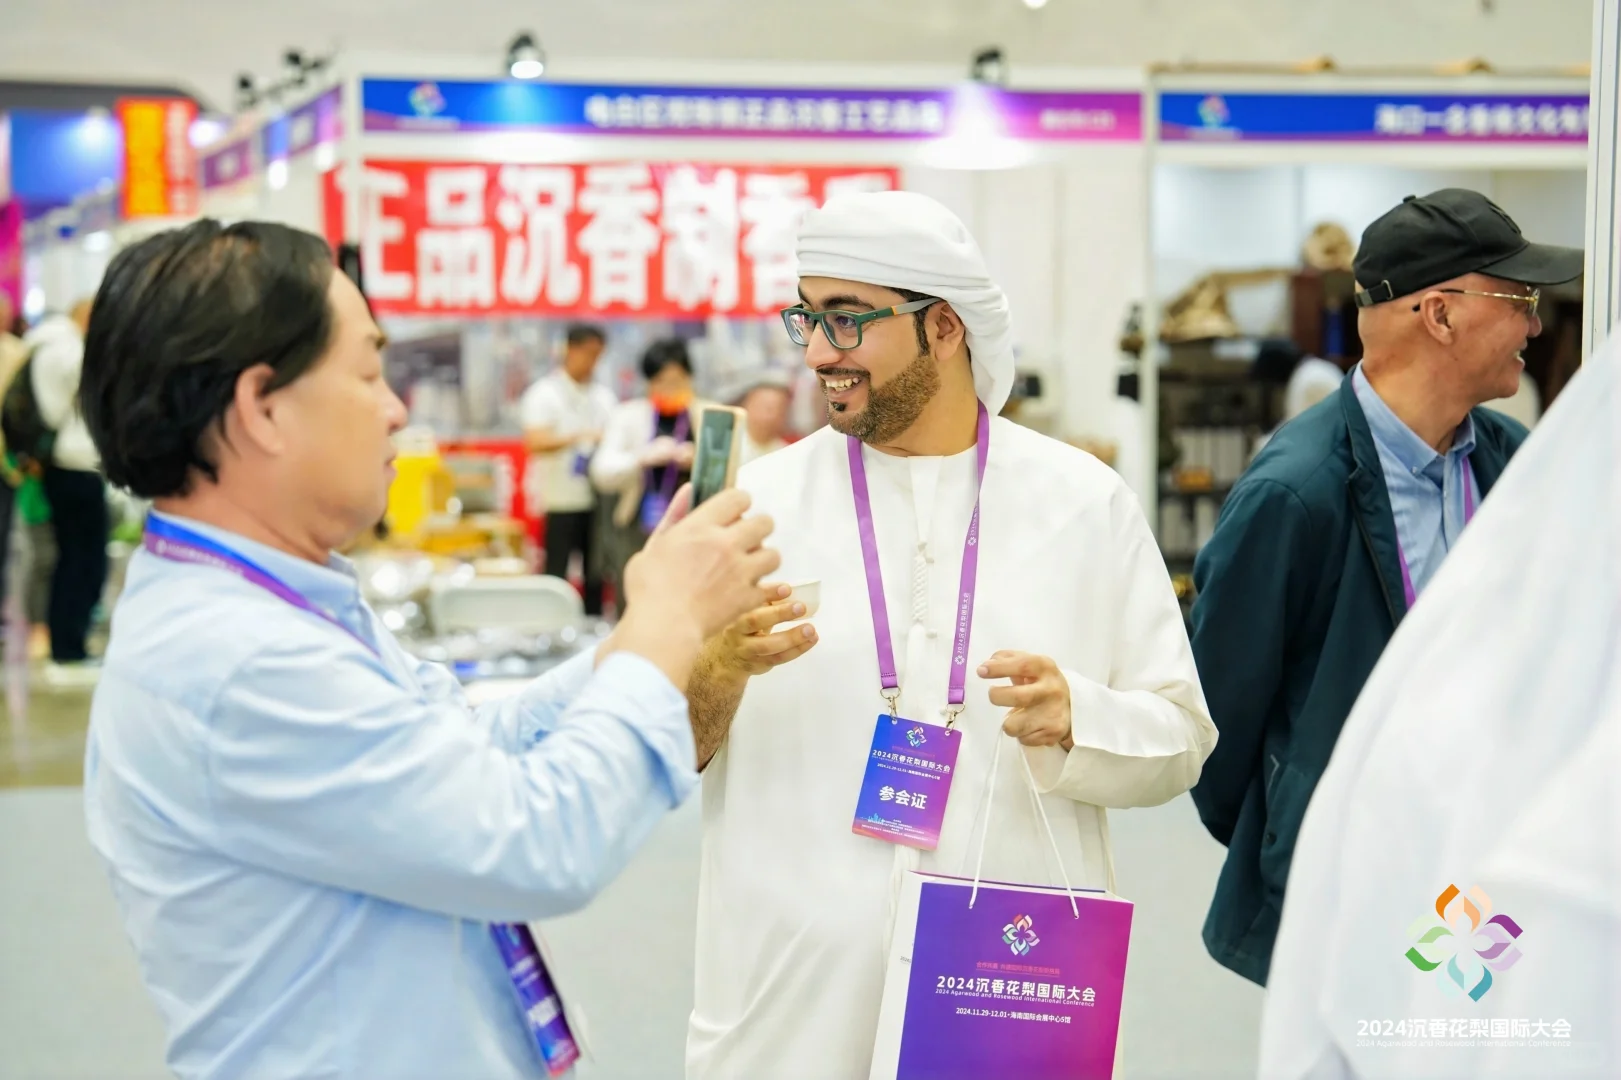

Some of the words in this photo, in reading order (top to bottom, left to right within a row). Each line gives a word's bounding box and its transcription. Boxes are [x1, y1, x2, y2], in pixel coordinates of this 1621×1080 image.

[336, 164, 893, 314] 正品沉香制香
[872, 749, 951, 773] 2024沉香花梨国际大会
[879, 785, 927, 810] 参会证
[936, 976, 1096, 1002] 2024沉香花梨国际大会
[950, 989, 979, 998] Agarwood
[993, 993, 1022, 1001] Rosewood
[1023, 996, 1061, 1004] International
[1062, 999, 1094, 1007] Conference
